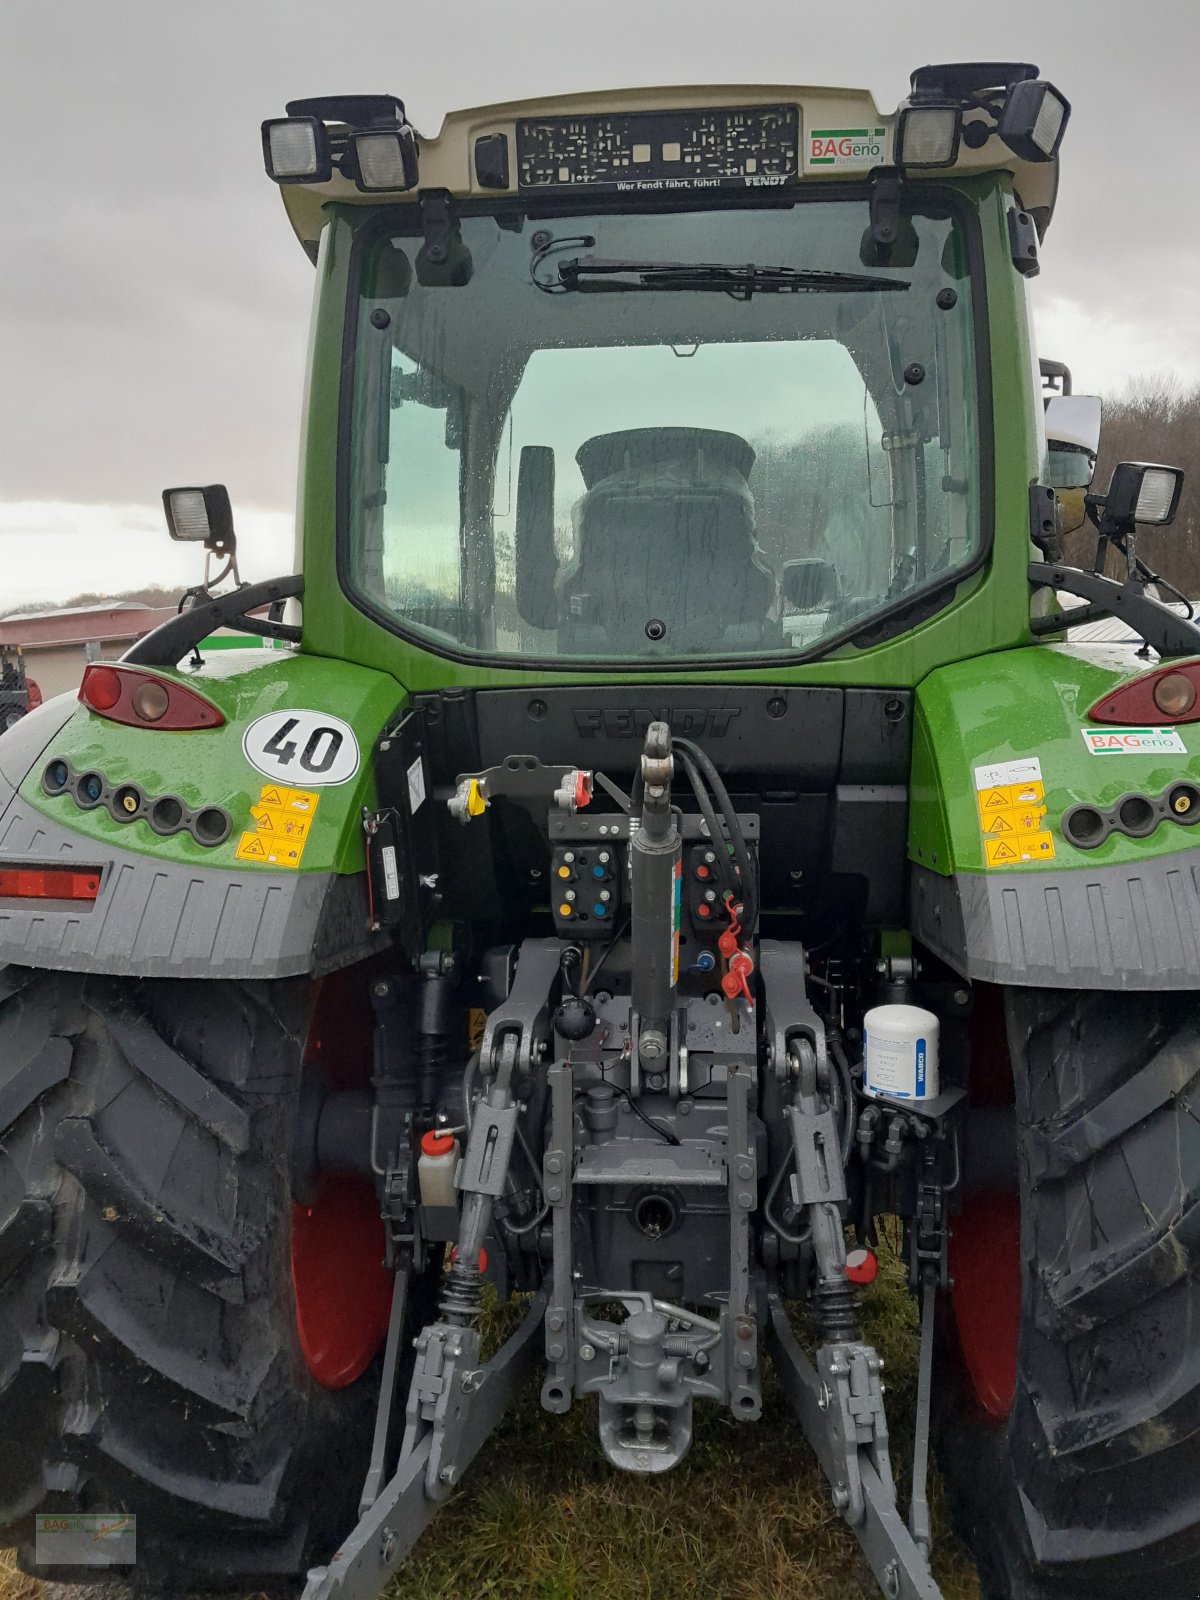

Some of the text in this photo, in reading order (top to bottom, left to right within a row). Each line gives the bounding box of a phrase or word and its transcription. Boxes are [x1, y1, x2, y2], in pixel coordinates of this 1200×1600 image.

[811, 138, 880, 157] BAGeno
[617, 178, 721, 191] Wer Fendt fährt, führt!
[744, 175, 788, 187] FENDT
[573, 707, 742, 739] FENDT
[262, 718, 344, 773] 40
[1090, 734, 1174, 748] BAGeno
